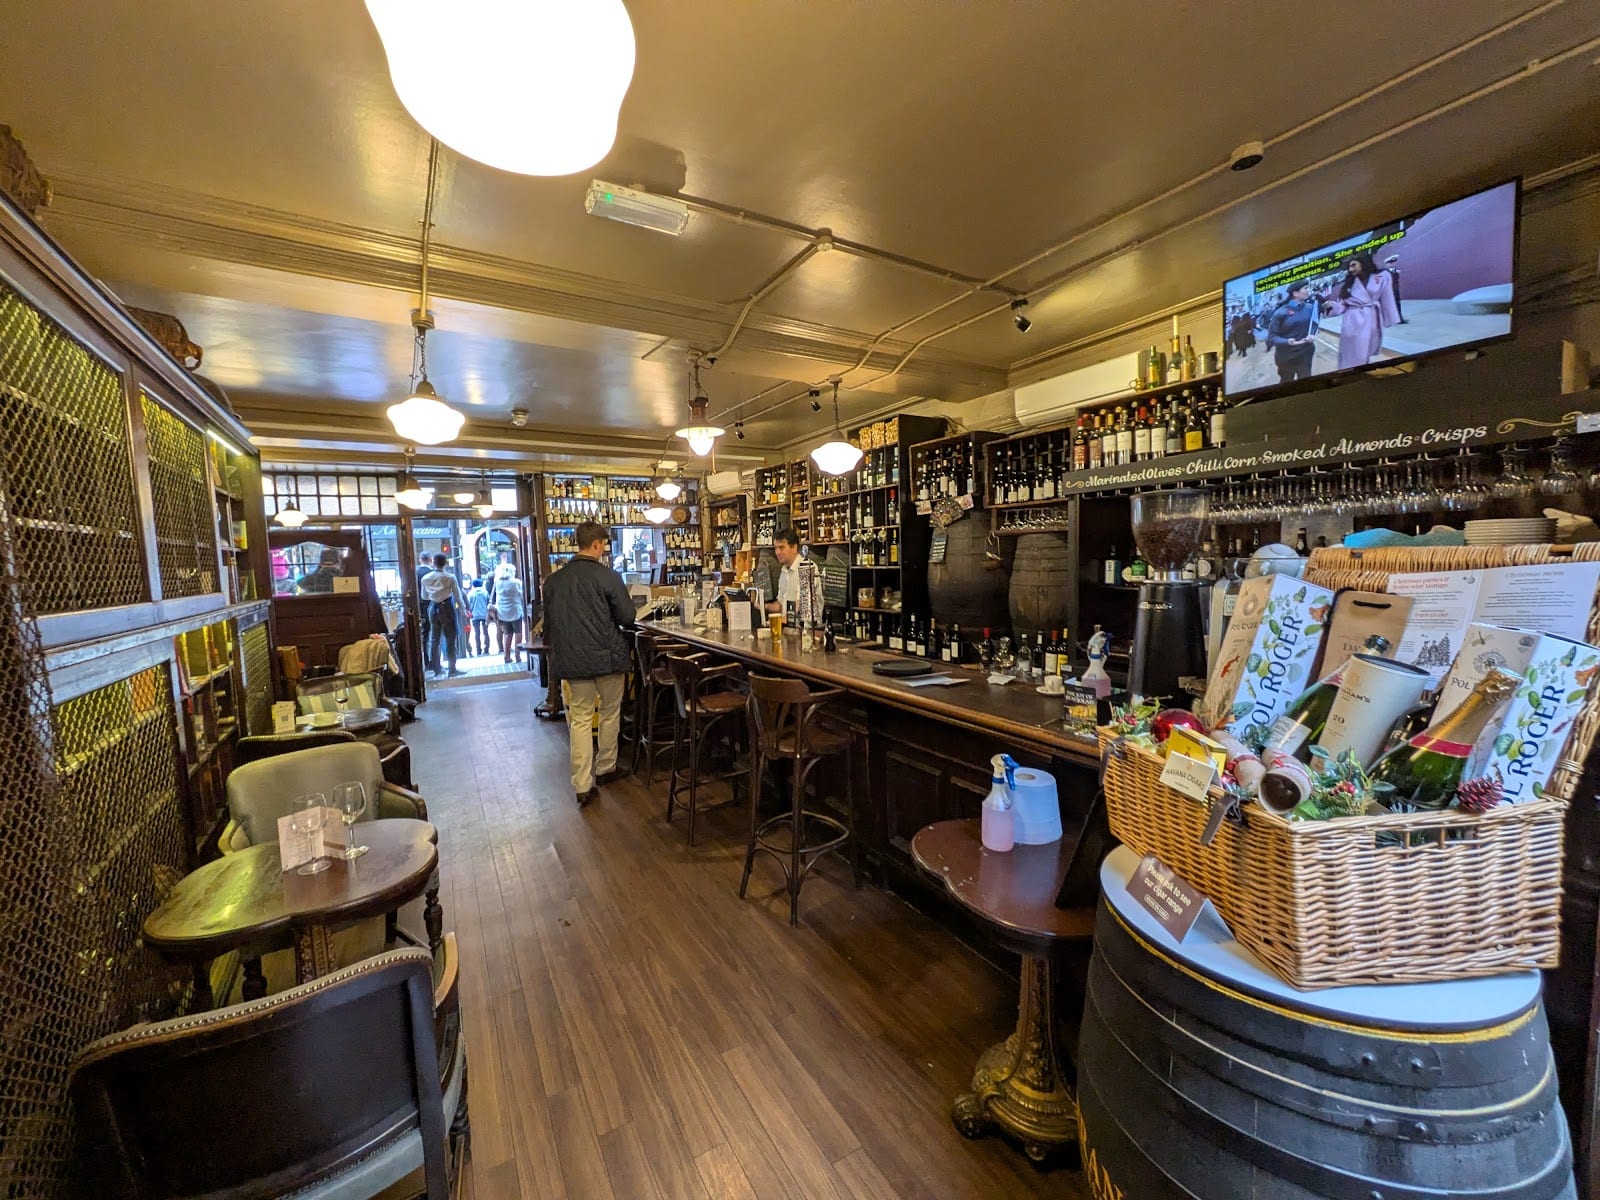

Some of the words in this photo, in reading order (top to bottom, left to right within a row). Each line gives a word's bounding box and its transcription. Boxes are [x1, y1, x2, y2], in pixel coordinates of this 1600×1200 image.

[1255, 270, 1291, 285] recovery
[1293, 256, 1332, 275] position.
[1334, 248, 1354, 259] She
[1356, 236, 1388, 252] ended
[1390, 231, 1405, 242] up
[1255, 281, 1278, 293] being
[1328, 262, 1340, 270] so
[1085, 469, 1146, 488] Marinated
[1146, 466, 1182, 480] Olives
[1186, 459, 1223, 475] Chilli
[1224, 456, 1257, 470] Corn
[1261, 443, 1327, 465] Smoked
[1330, 433, 1413, 457] Almonds
[1421, 425, 1488, 445] Crisps
[1260, 615, 1303, 693] ROGER
[1450, 677, 1471, 690] POL
[1332, 714, 1345, 724] 20
[1507, 685, 1566, 777] ROGER
[1144, 877, 1154, 888] our
[1153, 885, 1168, 901] cigar
[1166, 897, 1184, 915] range
[1148, 864, 1165, 884] Please
[1164, 880, 1175, 893] ask
[1173, 887, 1181, 897] to
[1180, 893, 1192, 906] see
